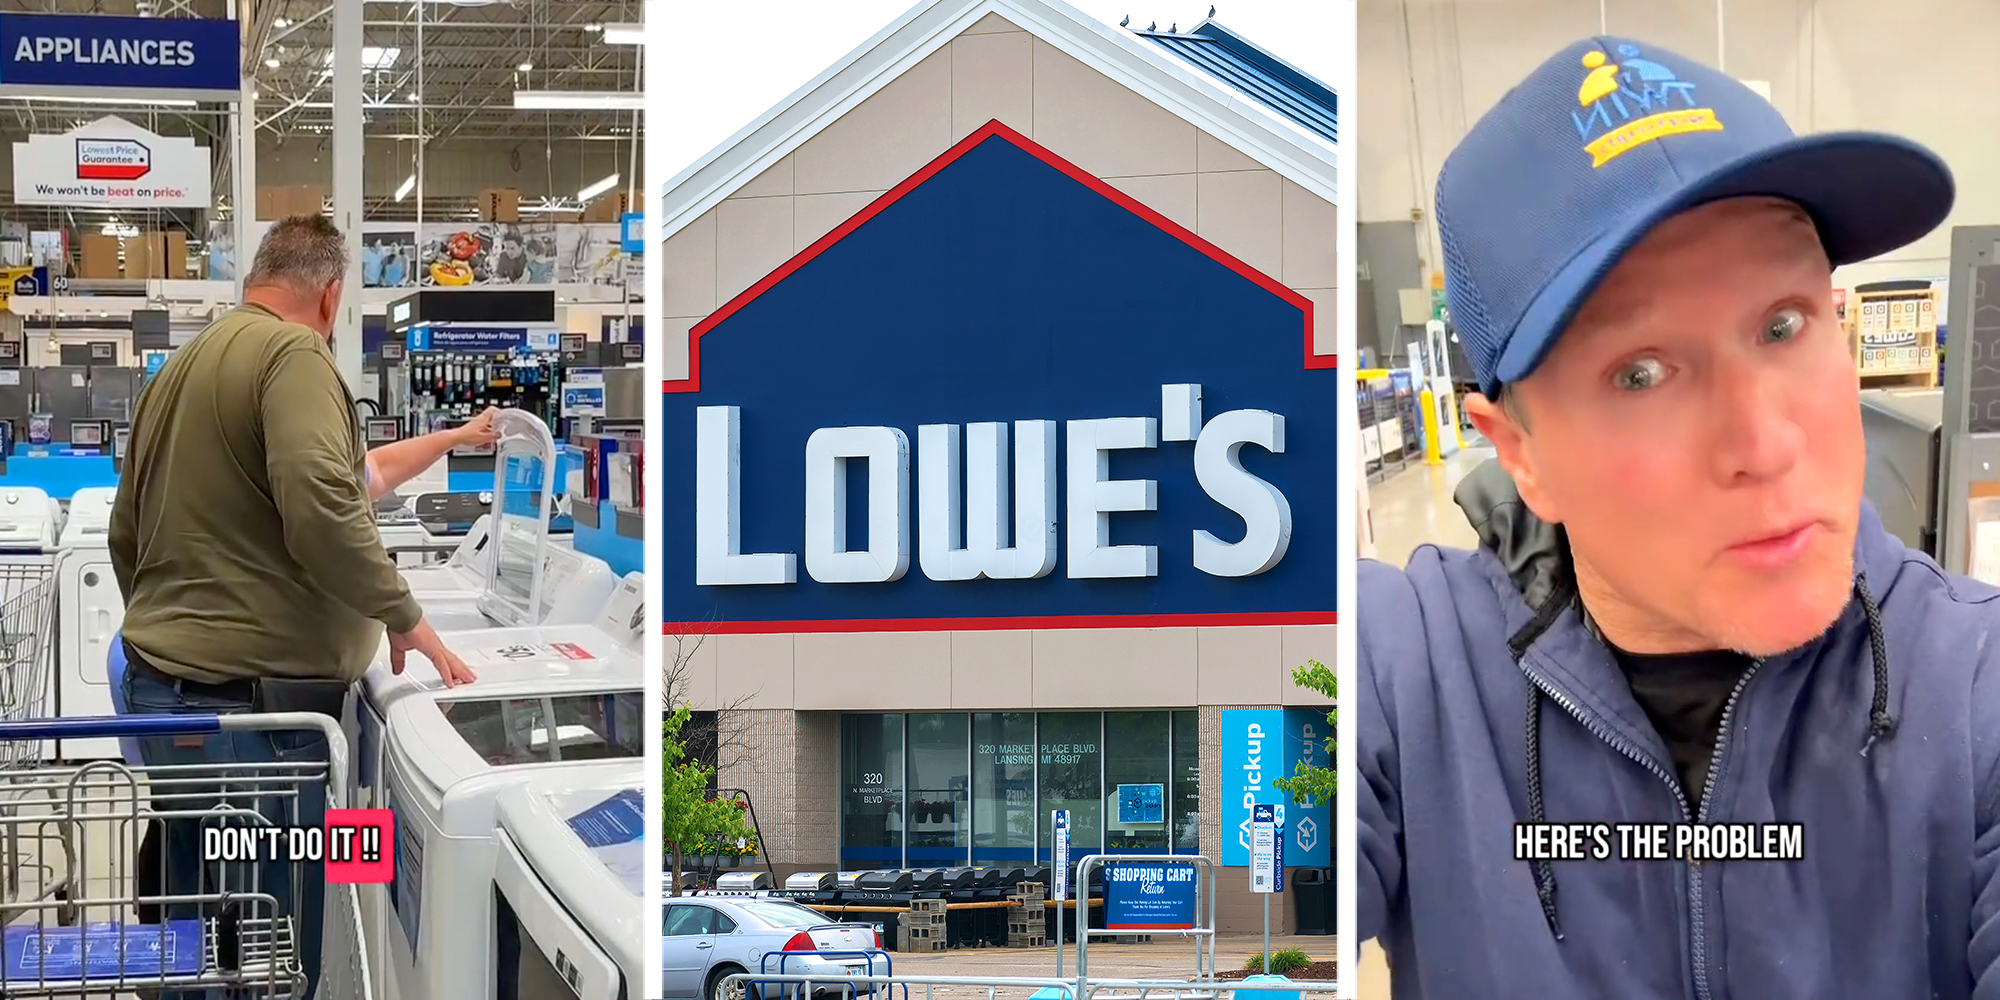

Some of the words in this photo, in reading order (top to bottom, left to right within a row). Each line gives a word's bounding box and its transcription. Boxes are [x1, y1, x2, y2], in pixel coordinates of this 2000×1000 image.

[14, 36, 195, 66] APPLIANCES
[81, 145, 114, 154] Lowest
[116, 146, 138, 155] Price
[82, 155, 133, 164] Guarantee
[35, 184, 54, 194] We
[56, 186, 89, 196] won't
[91, 186, 105, 196] be
[108, 186, 134, 196] beat
[54, 277, 68, 289] 60
[433, 332, 475, 340] Refrigerator
[500, 332, 521, 340] Filters
[696, 383, 1293, 585] LOWE'S
[978, 745, 996, 754] 320
[1000, 745, 1034, 753] MARKET
[1041, 744, 1069, 753] PLACE
[1073, 744, 1098, 753] BLVD.
[1041, 755, 1051, 764] MI
[1054, 755, 1081, 764] 48917
[1243, 723, 1265, 808] Pickup
[863, 773, 883, 784] 320
[863, 796, 883, 804] BLVD
[1275, 807, 1283, 819] 4
[1113, 868, 1164, 881] SHOPPING
[1166, 868, 1194, 881] CART
[1140, 877, 1166, 894] Return
